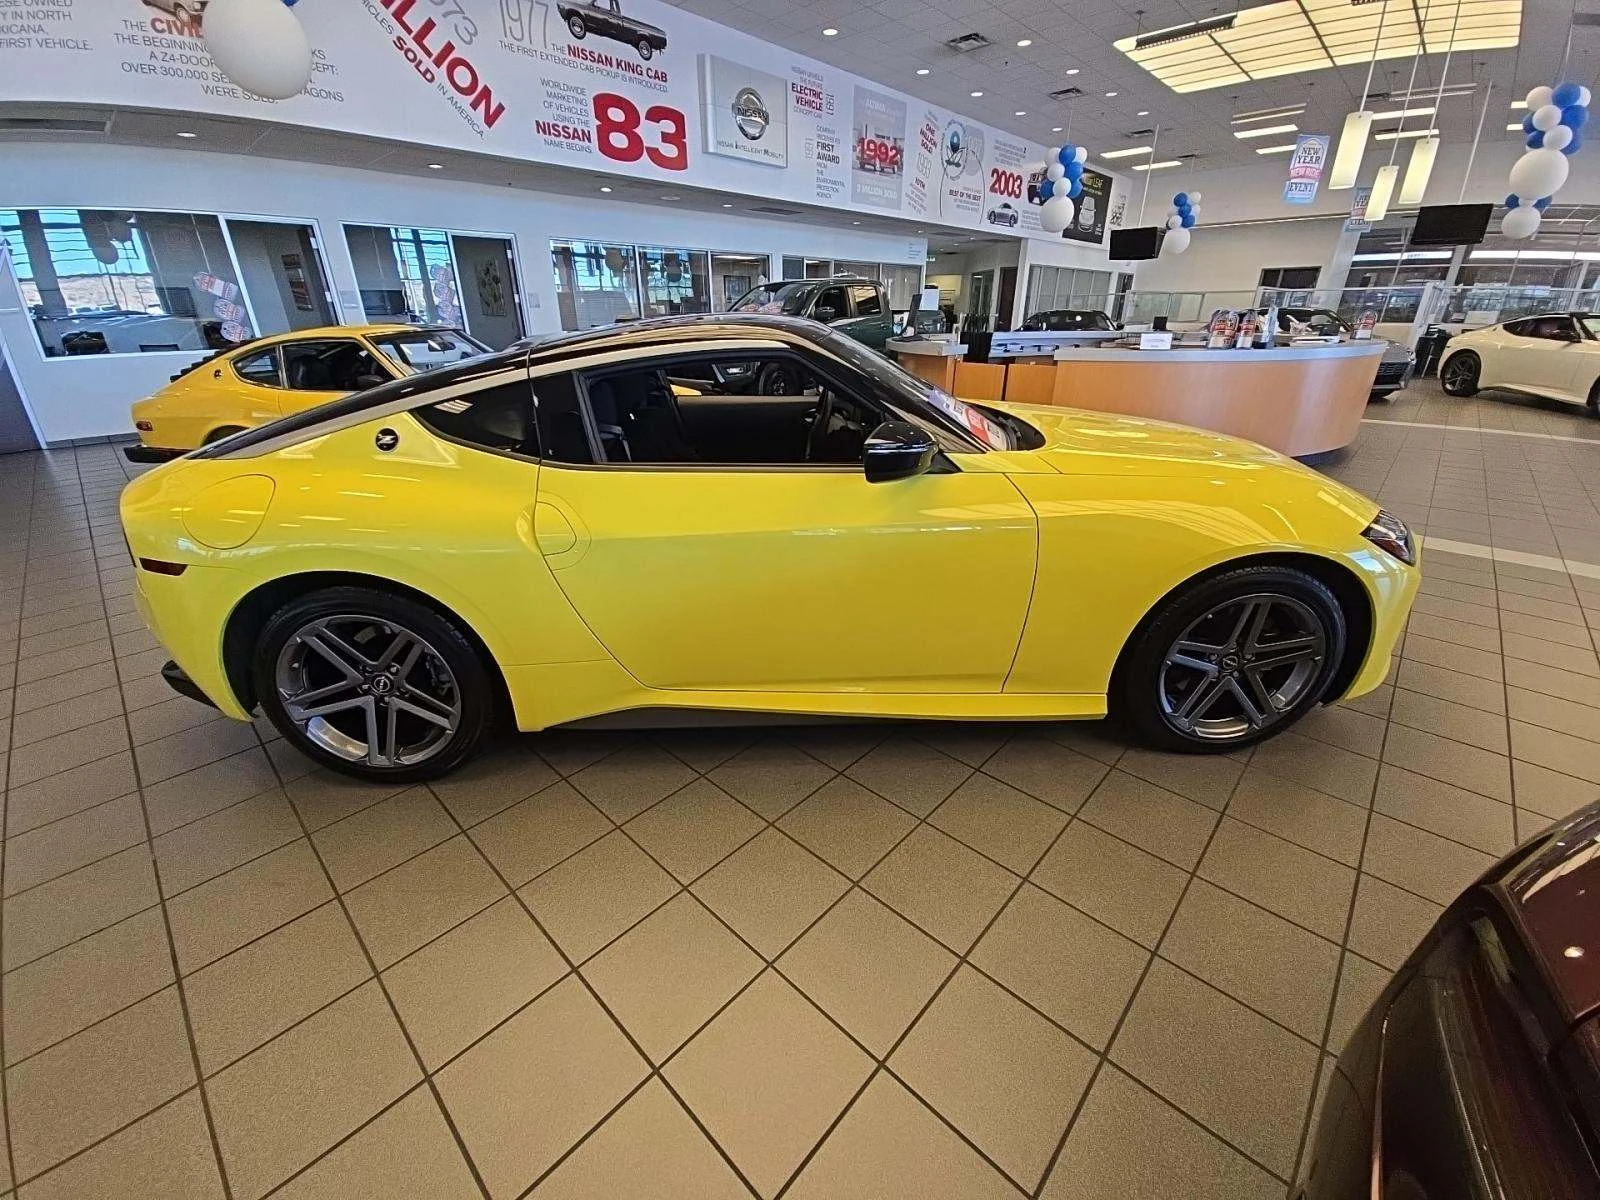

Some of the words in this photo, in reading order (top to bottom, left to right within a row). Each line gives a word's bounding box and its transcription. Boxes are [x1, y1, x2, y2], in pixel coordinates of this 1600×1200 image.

[11, 10, 24, 20] IN
[26, 10, 73, 21] NORTH
[121, 19, 147, 32] THE
[150, 17, 205, 39] CIVIL
[113, 32, 140, 46] THE
[149, 50, 158, 61] A
[378, 0, 506, 129] LLION
[498, 40, 514, 53] THE
[517, 44, 539, 59] FIRST
[540, 52, 579, 69] EXTENDED
[579, 62, 595, 73] CAB
[595, 67, 620, 80] PICKUP
[551, 43, 567, 55] THE
[566, 44, 613, 68] NISSAN
[615, 58, 643, 76] KING
[646, 68, 669, 83] CAB
[121, 61, 157, 75] OVER
[211, 71, 231, 84] SE
[392, 35, 436, 84] SOLD
[436, 82, 448, 96] IN
[201, 83, 240, 99] WERE
[540, 77, 587, 97] WORLDWIDE
[792, 82, 823, 101] ELECTRIC
[546, 90, 588, 107] MARKETING
[795, 94, 823, 112] VEHICLE
[543, 100, 555, 110] OF
[554, 103, 589, 118] VEHICLES
[737, 106, 768, 122] NISSAN
[552, 113, 577, 125] USING
[576, 117, 590, 129] THE
[534, 119, 592, 144] NISSAN
[592, 92, 689, 171] 83
[544, 138, 565, 150] NAME
[816, 141, 834, 153] FIRST
[857, 137, 899, 166] 1992
[1301, 147, 1320, 156] NEW
[816, 151, 840, 164] AWARD
[1297, 155, 1321, 165] YEAR
[989, 168, 1023, 199] 2003
